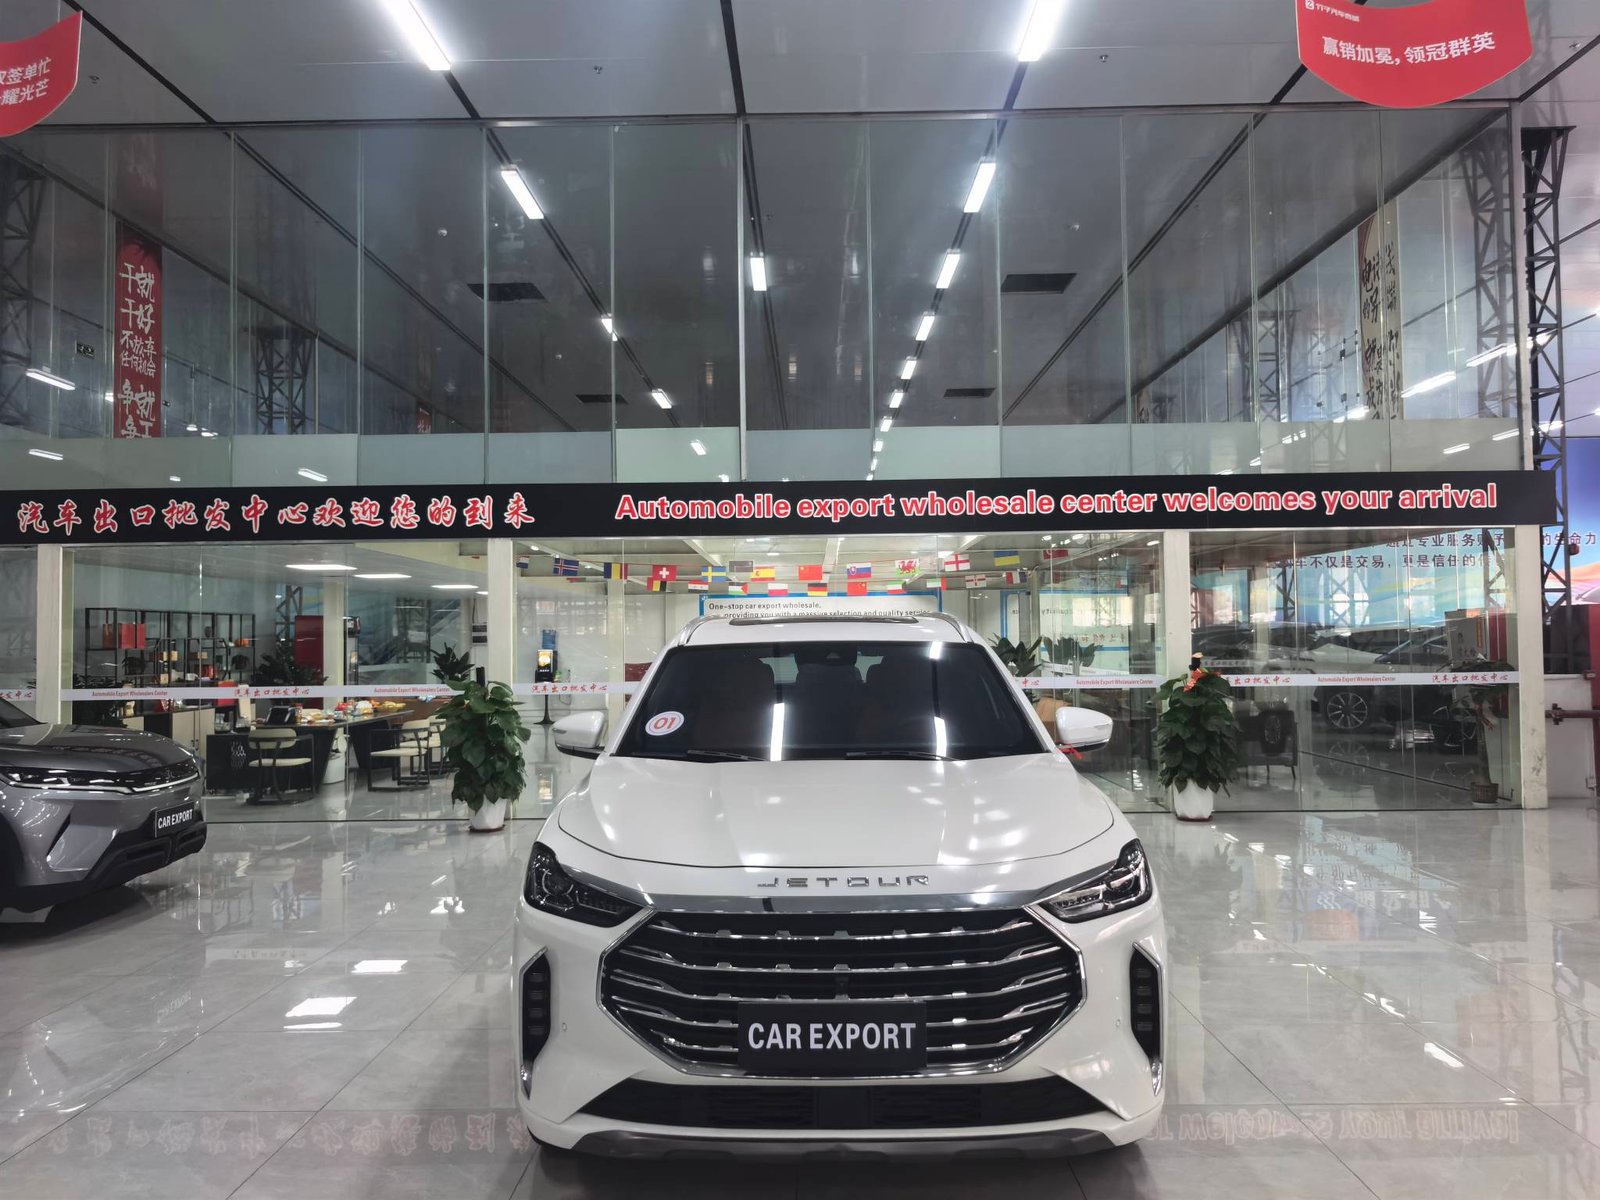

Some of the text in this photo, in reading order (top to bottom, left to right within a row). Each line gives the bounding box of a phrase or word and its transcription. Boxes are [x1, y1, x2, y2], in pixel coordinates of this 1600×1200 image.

[614, 482, 1498, 523] Automobile export wholesale center welcomes your arrival
[17, 492, 536, 536] 汽车出口批发中心欢迎您的到来
[708, 603, 744, 612] One-stop
[757, 602, 781, 611] export
[1432, 673, 1509, 684] 汽车出口批发中心
[234, 686, 310, 697] 汽车出口批发中心
[531, 683, 608, 694] 汽车出口批发中心
[157, 808, 193, 829] CAR EXPORT
[757, 875, 930, 888] JETOUR
[748, 1022, 917, 1050] CAR EXPORT
